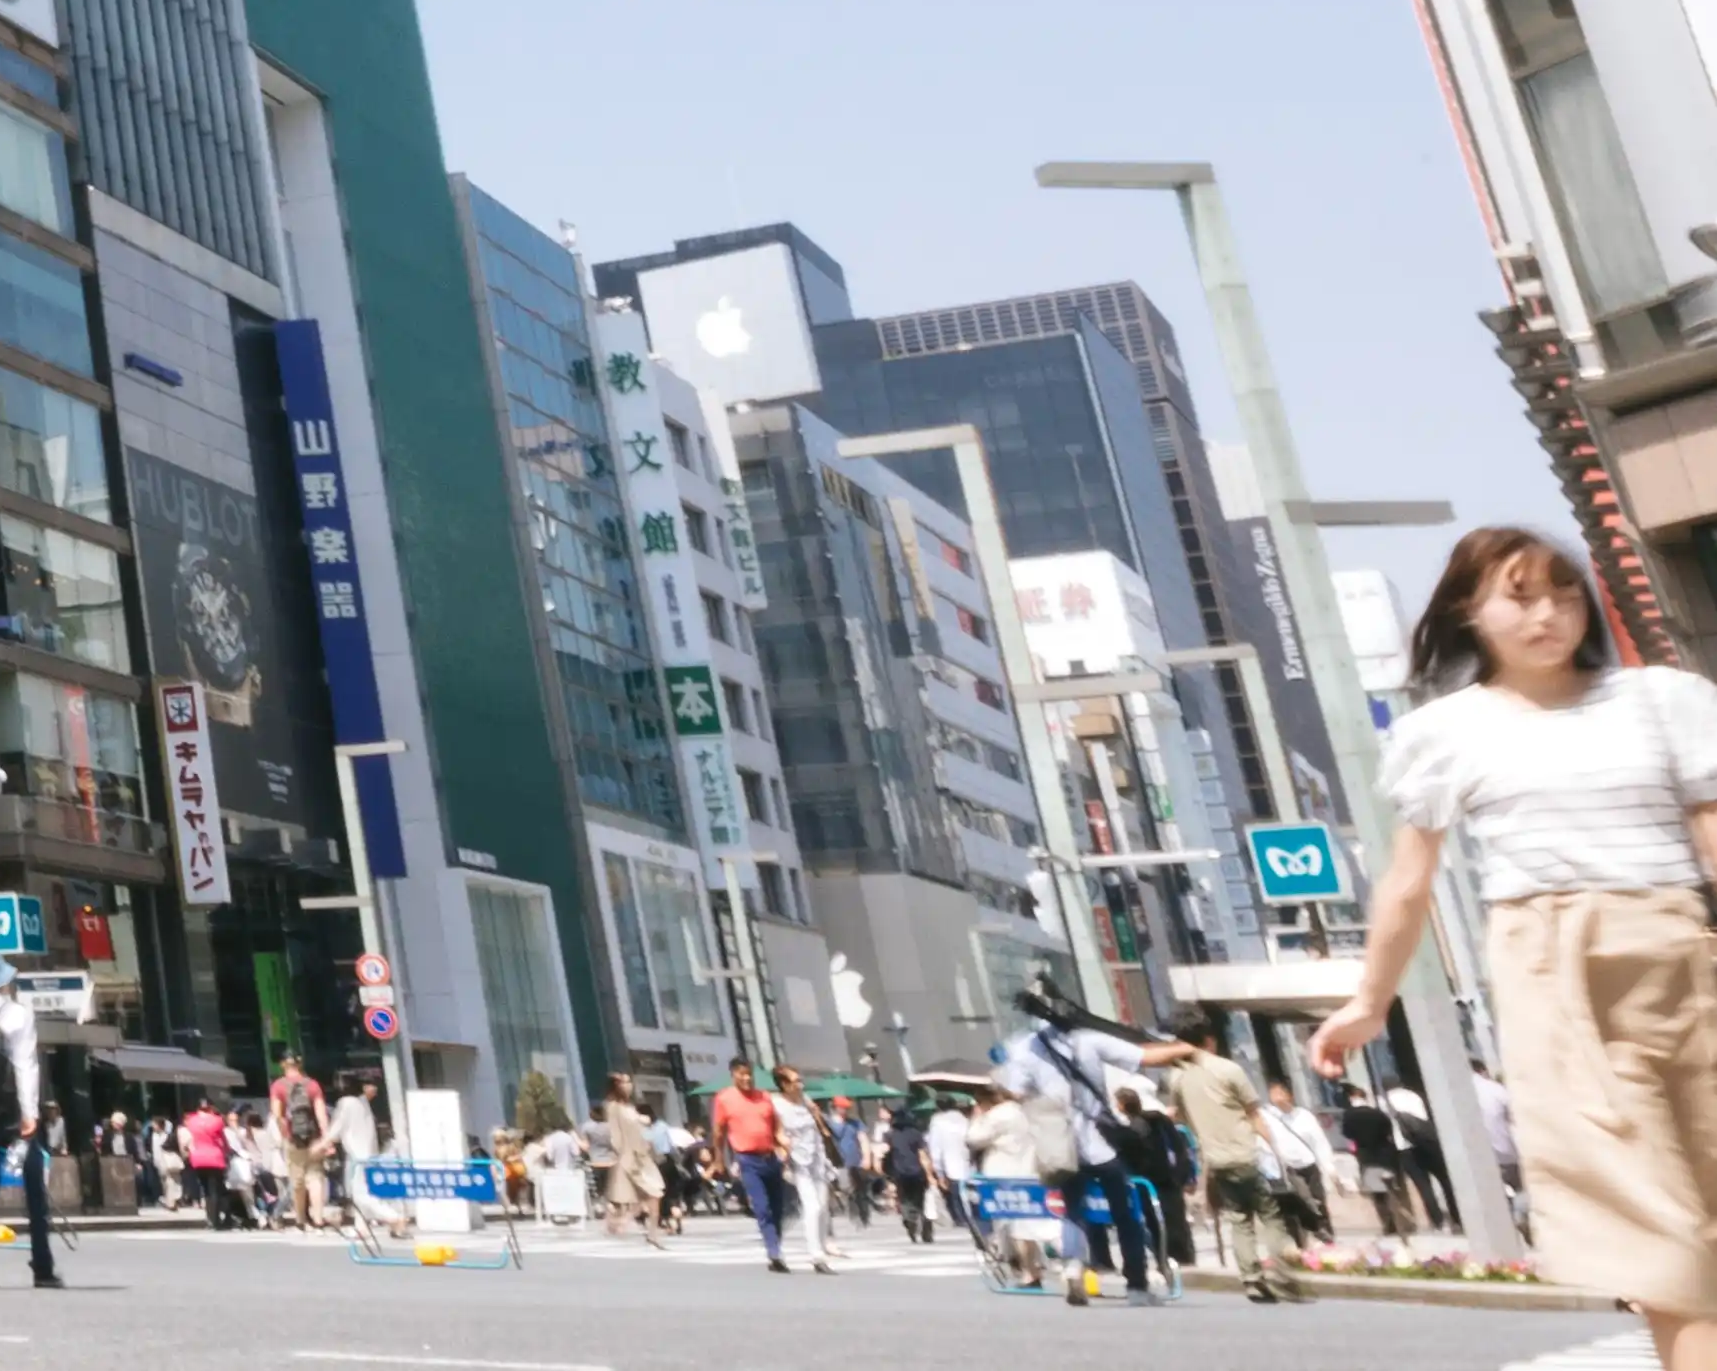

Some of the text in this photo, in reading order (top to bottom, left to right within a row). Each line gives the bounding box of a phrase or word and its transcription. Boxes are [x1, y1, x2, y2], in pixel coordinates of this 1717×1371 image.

[130, 459, 260, 555] HUBLOT
[293, 419, 357, 619] 山野楽器
[606, 350, 679, 555] 教文館
[671, 676, 714, 725] 本
[175, 742, 215, 891] キムラヤのパン
